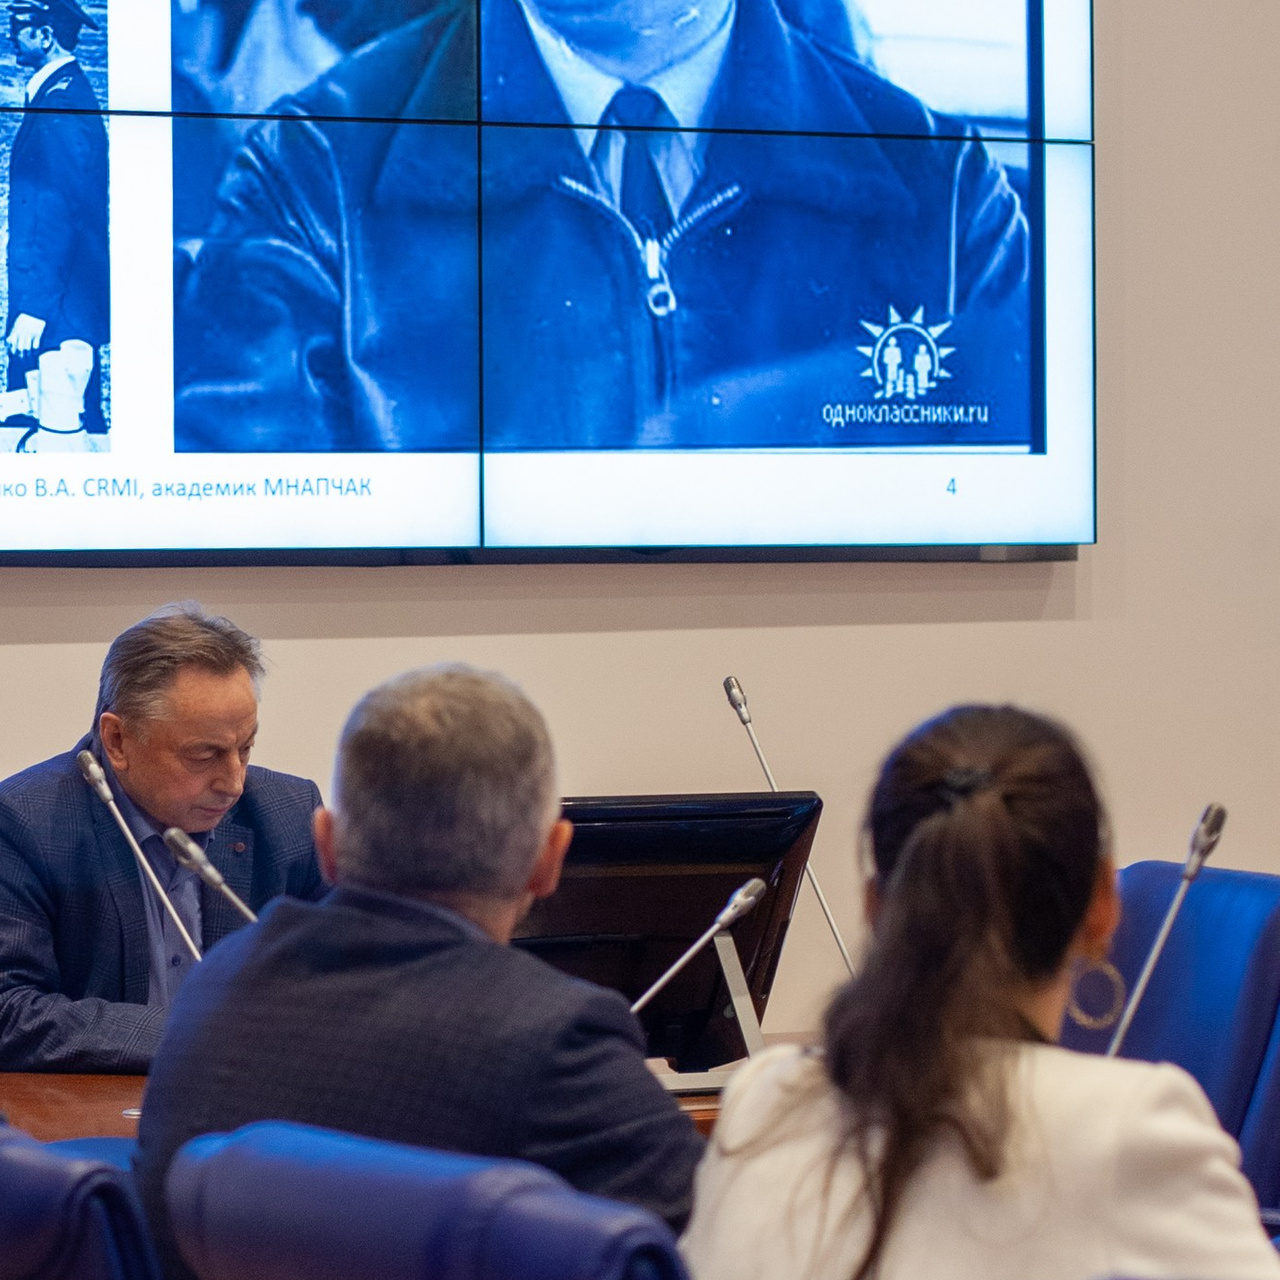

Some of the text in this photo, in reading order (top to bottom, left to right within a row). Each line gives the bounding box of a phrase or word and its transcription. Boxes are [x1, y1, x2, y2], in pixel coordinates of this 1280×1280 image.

[822, 404, 989, 426] одноклассники.ru
[35, 478, 76, 497] В.А.
[82, 478, 145, 500] CRMI,
[151, 482, 256, 501] академик
[264, 477, 372, 498] МНАПЧАК
[946, 477, 958, 495] 4
